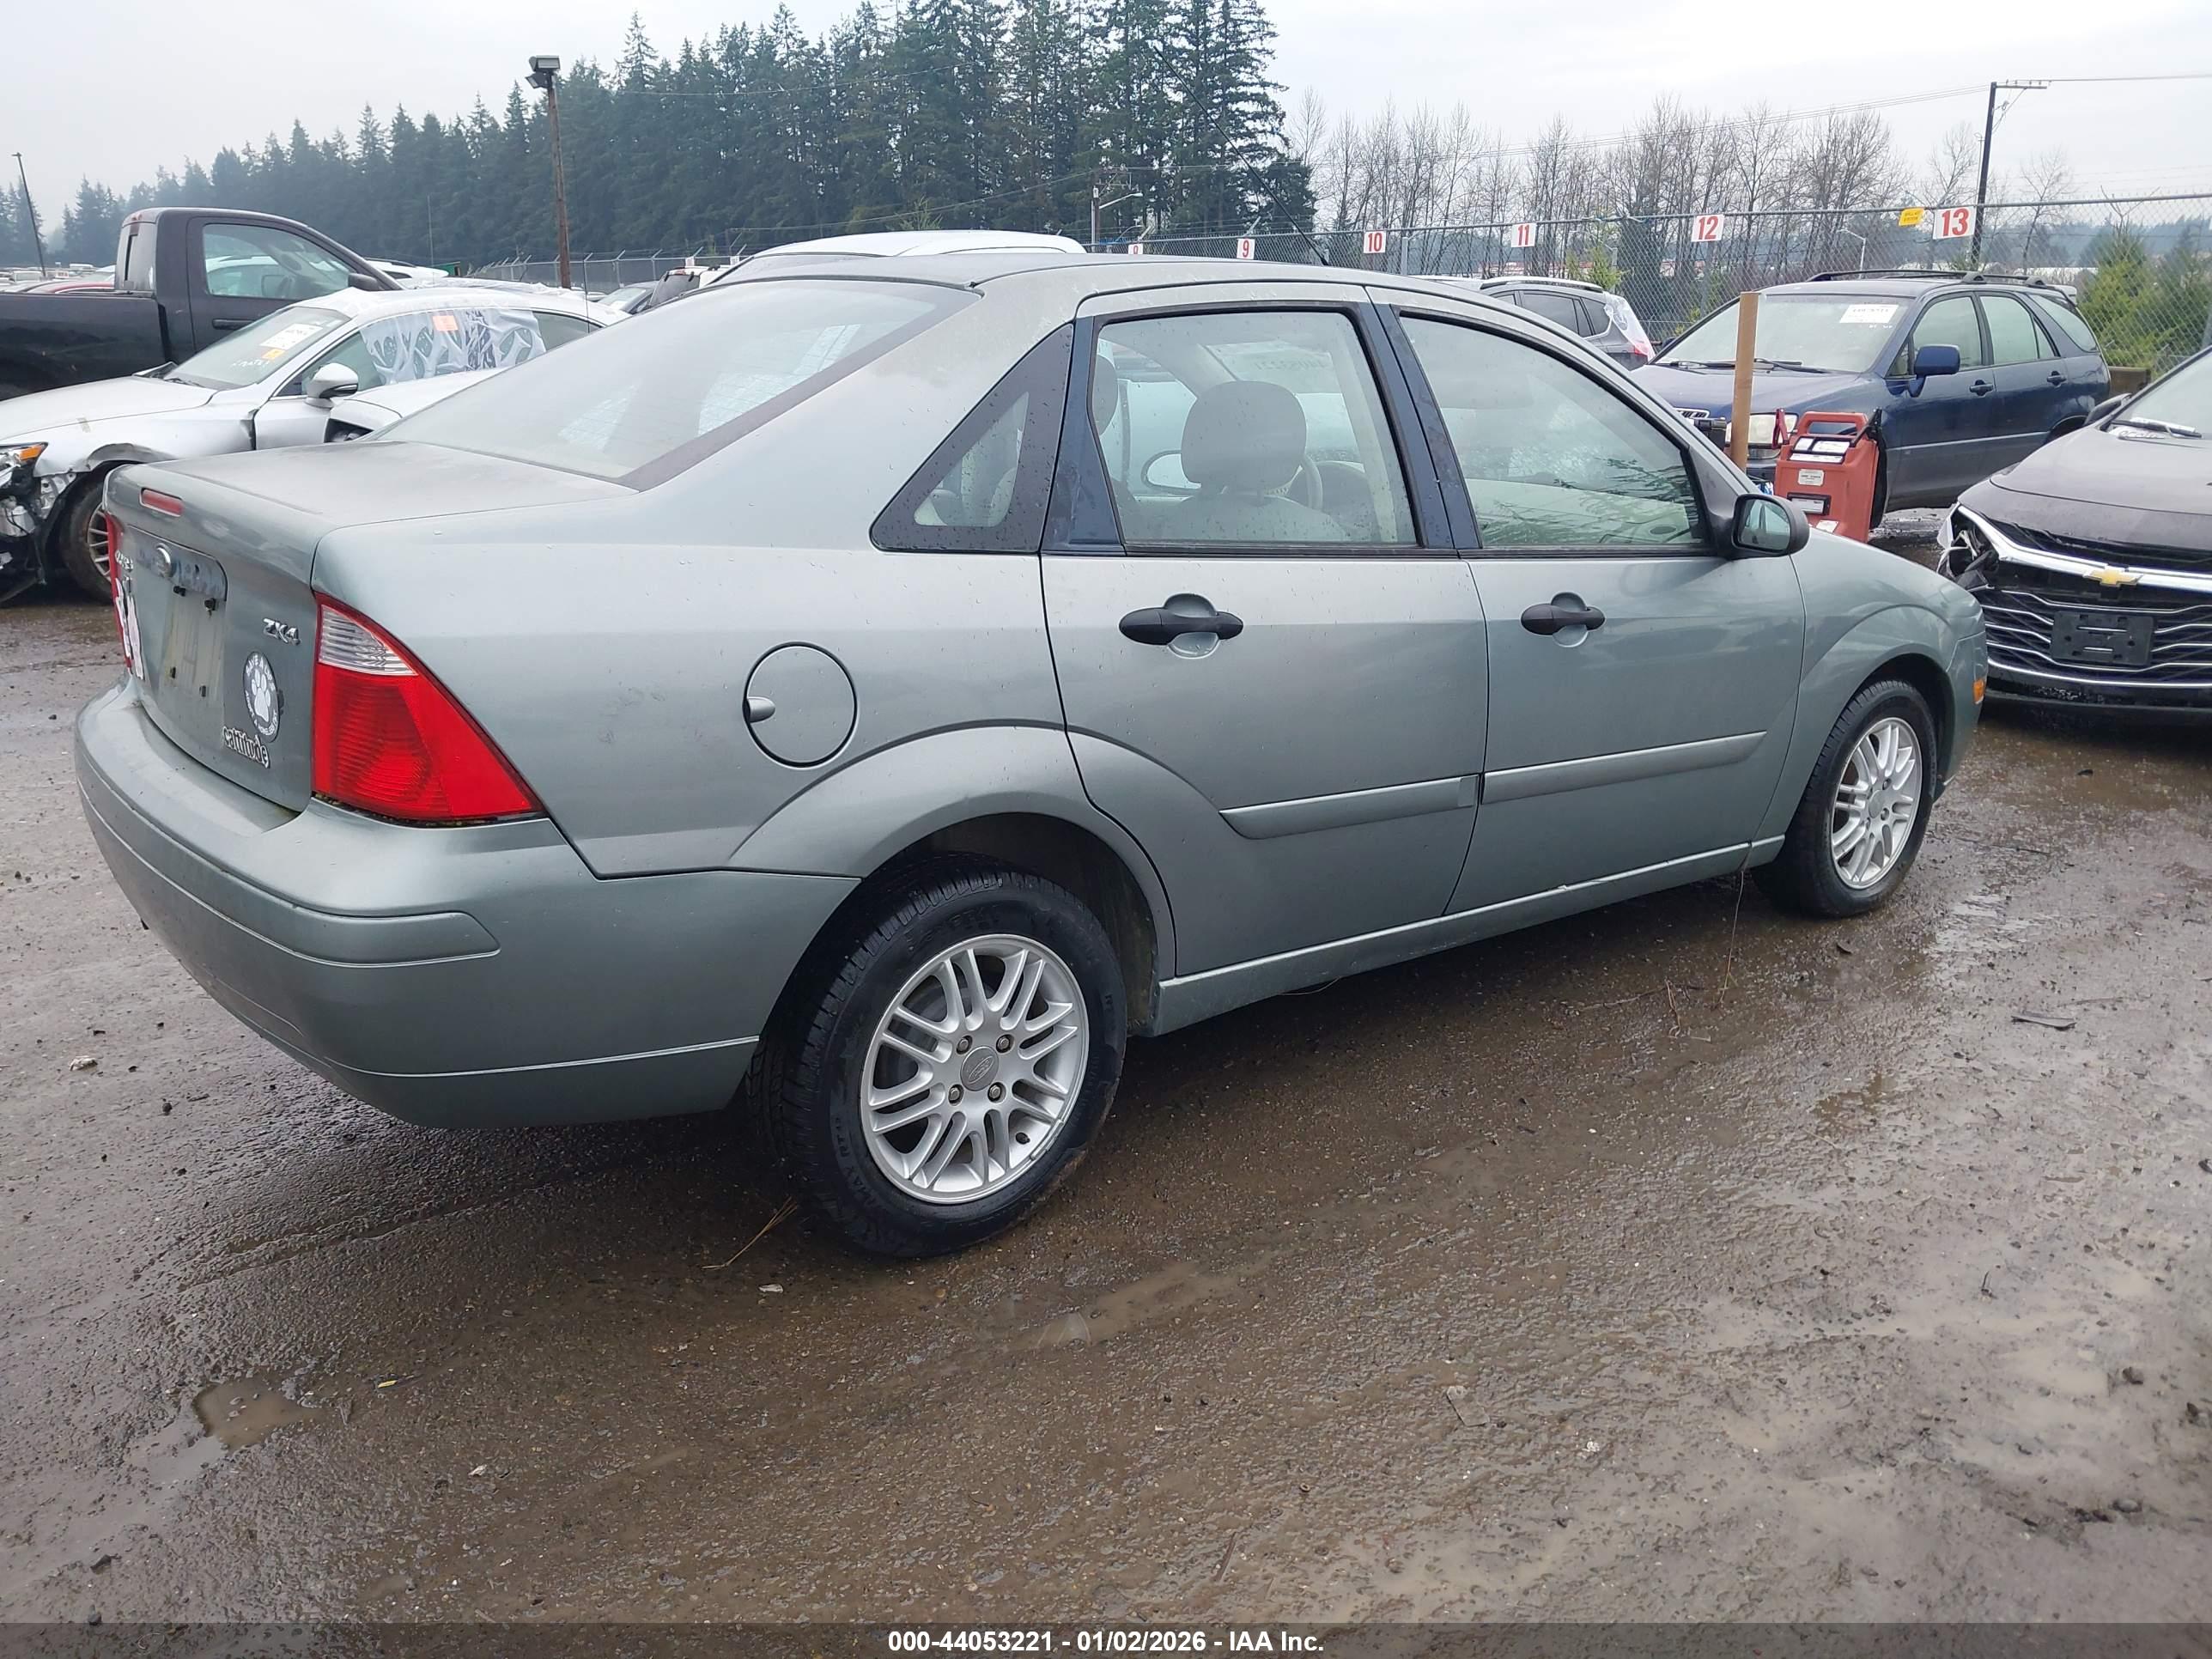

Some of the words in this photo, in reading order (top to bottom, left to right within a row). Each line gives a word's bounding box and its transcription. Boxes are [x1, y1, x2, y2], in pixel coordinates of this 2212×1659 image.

[1698, 216, 1719, 240] 12
[1942, 208, 1969, 236] 13
[1367, 232, 1383, 252] 10
[1517, 224, 1530, 246] 11
[1242, 240, 1250, 258] 9
[263, 617, 301, 645] ZX4
